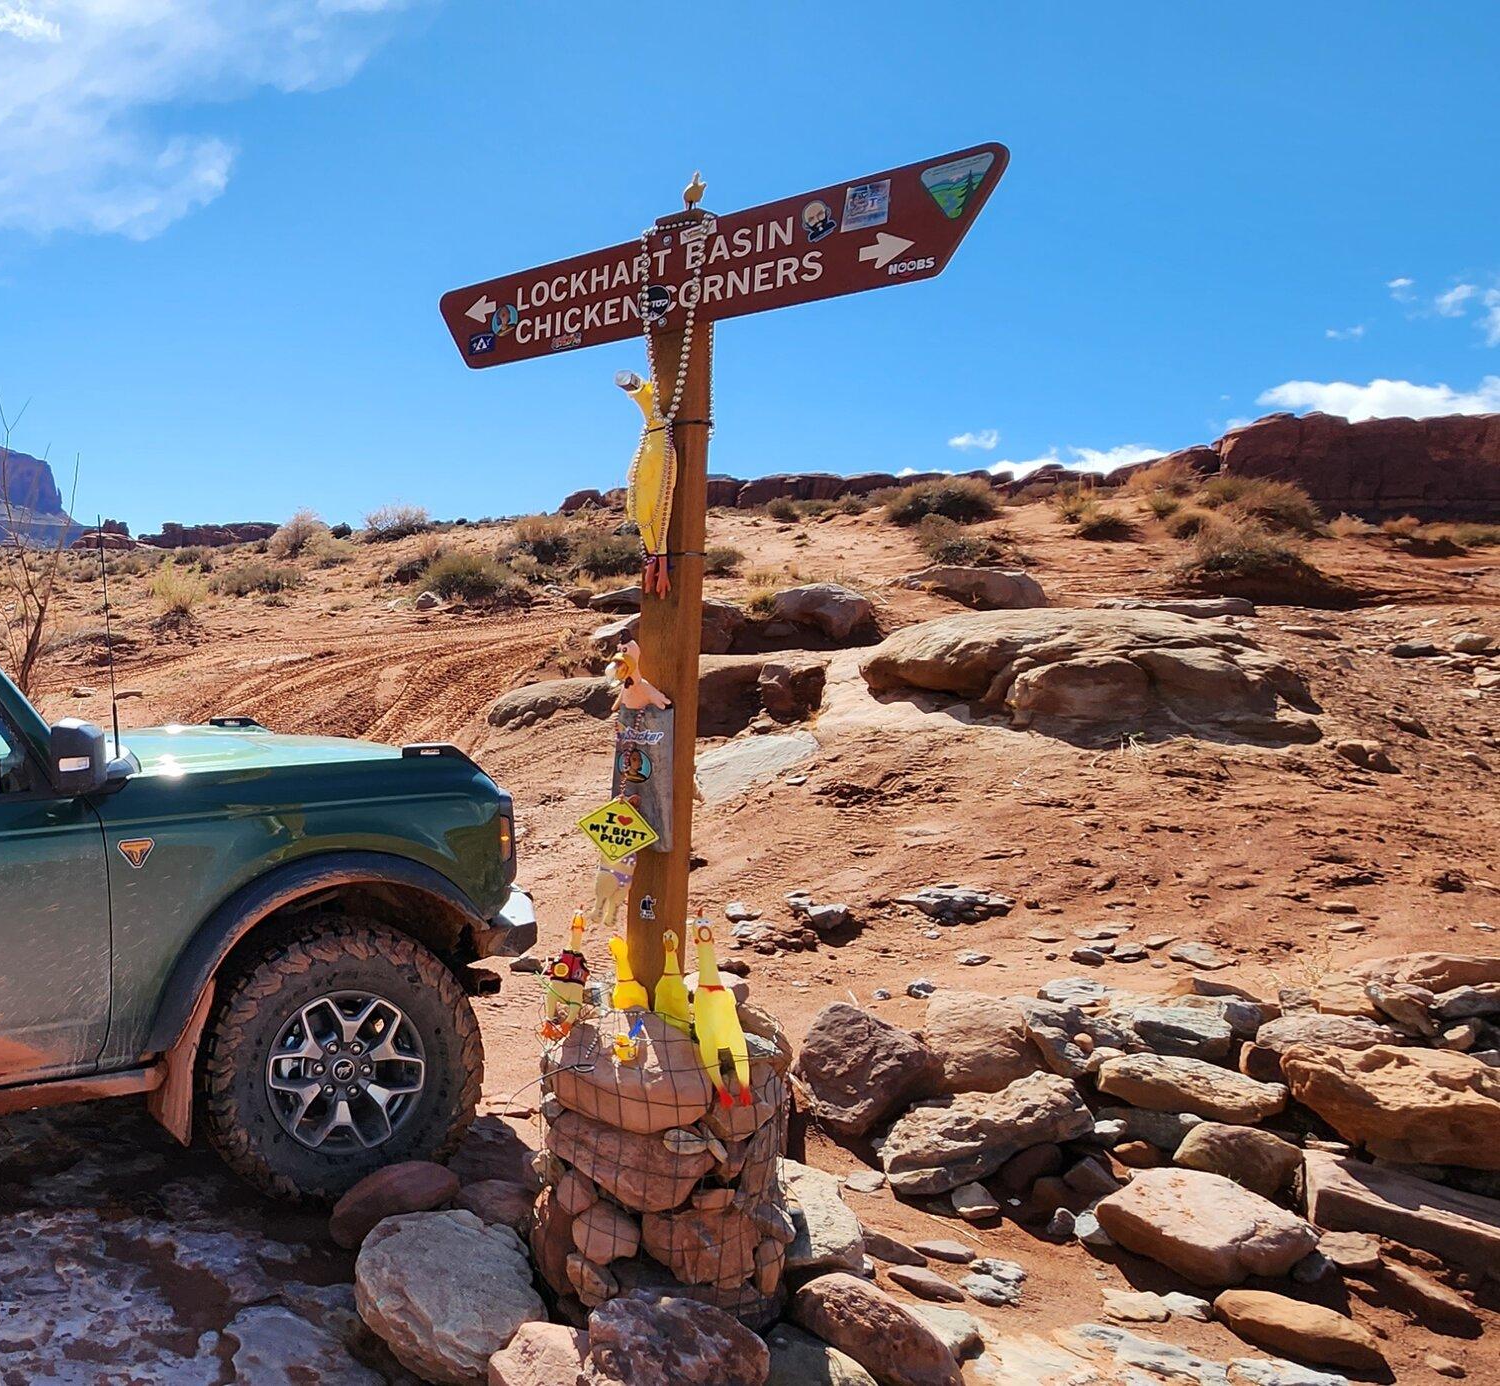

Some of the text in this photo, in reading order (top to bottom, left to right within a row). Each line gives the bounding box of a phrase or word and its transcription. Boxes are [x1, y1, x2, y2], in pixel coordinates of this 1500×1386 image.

[516, 248, 672, 312] LOCKHART
[685, 216, 794, 270] BASIN
[888, 257, 935, 275] NOOBS
[515, 292, 643, 344] CHICKEN
[605, 812, 617, 824] I
[589, 823, 647, 840] MY BUTT
[600, 834, 633, 847] PLUG
